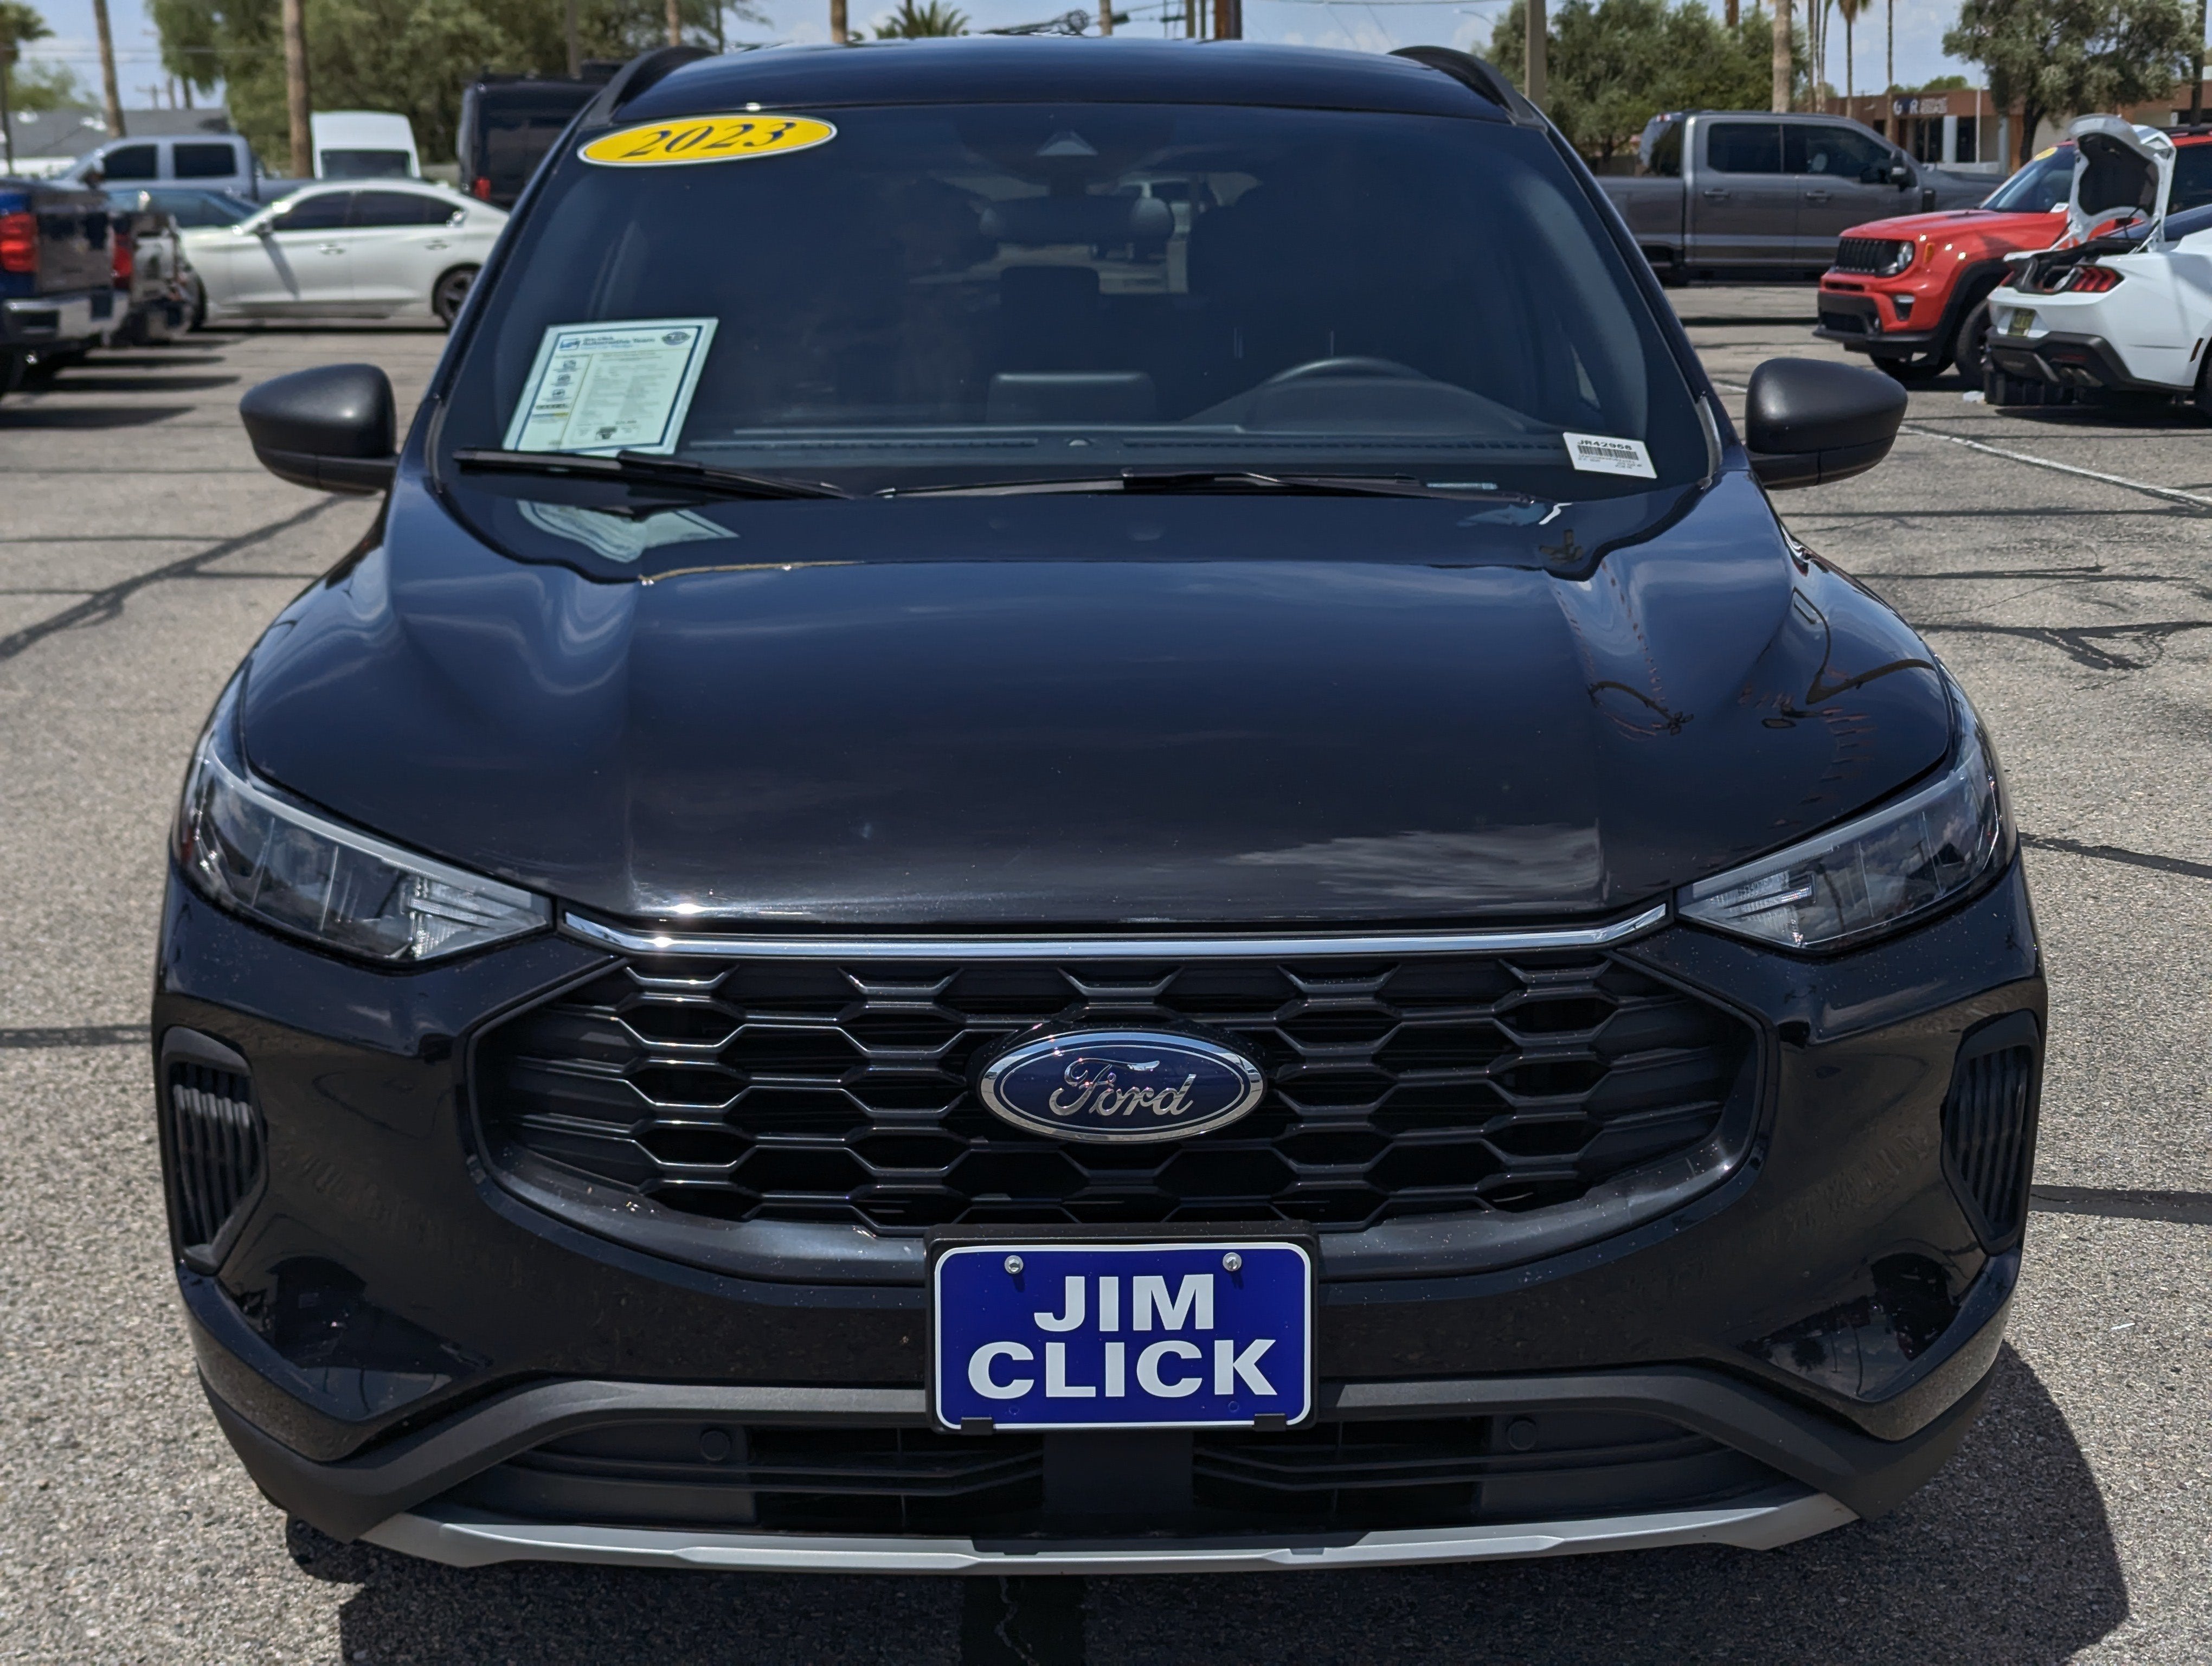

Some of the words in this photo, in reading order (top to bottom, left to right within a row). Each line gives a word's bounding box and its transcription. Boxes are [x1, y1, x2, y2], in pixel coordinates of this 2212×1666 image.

[619, 121, 796, 158] 2023
[1049, 1058, 1197, 1116] Ford
[1034, 1274, 1214, 1332] JIM
[968, 1340, 1277, 1400] CLICK
